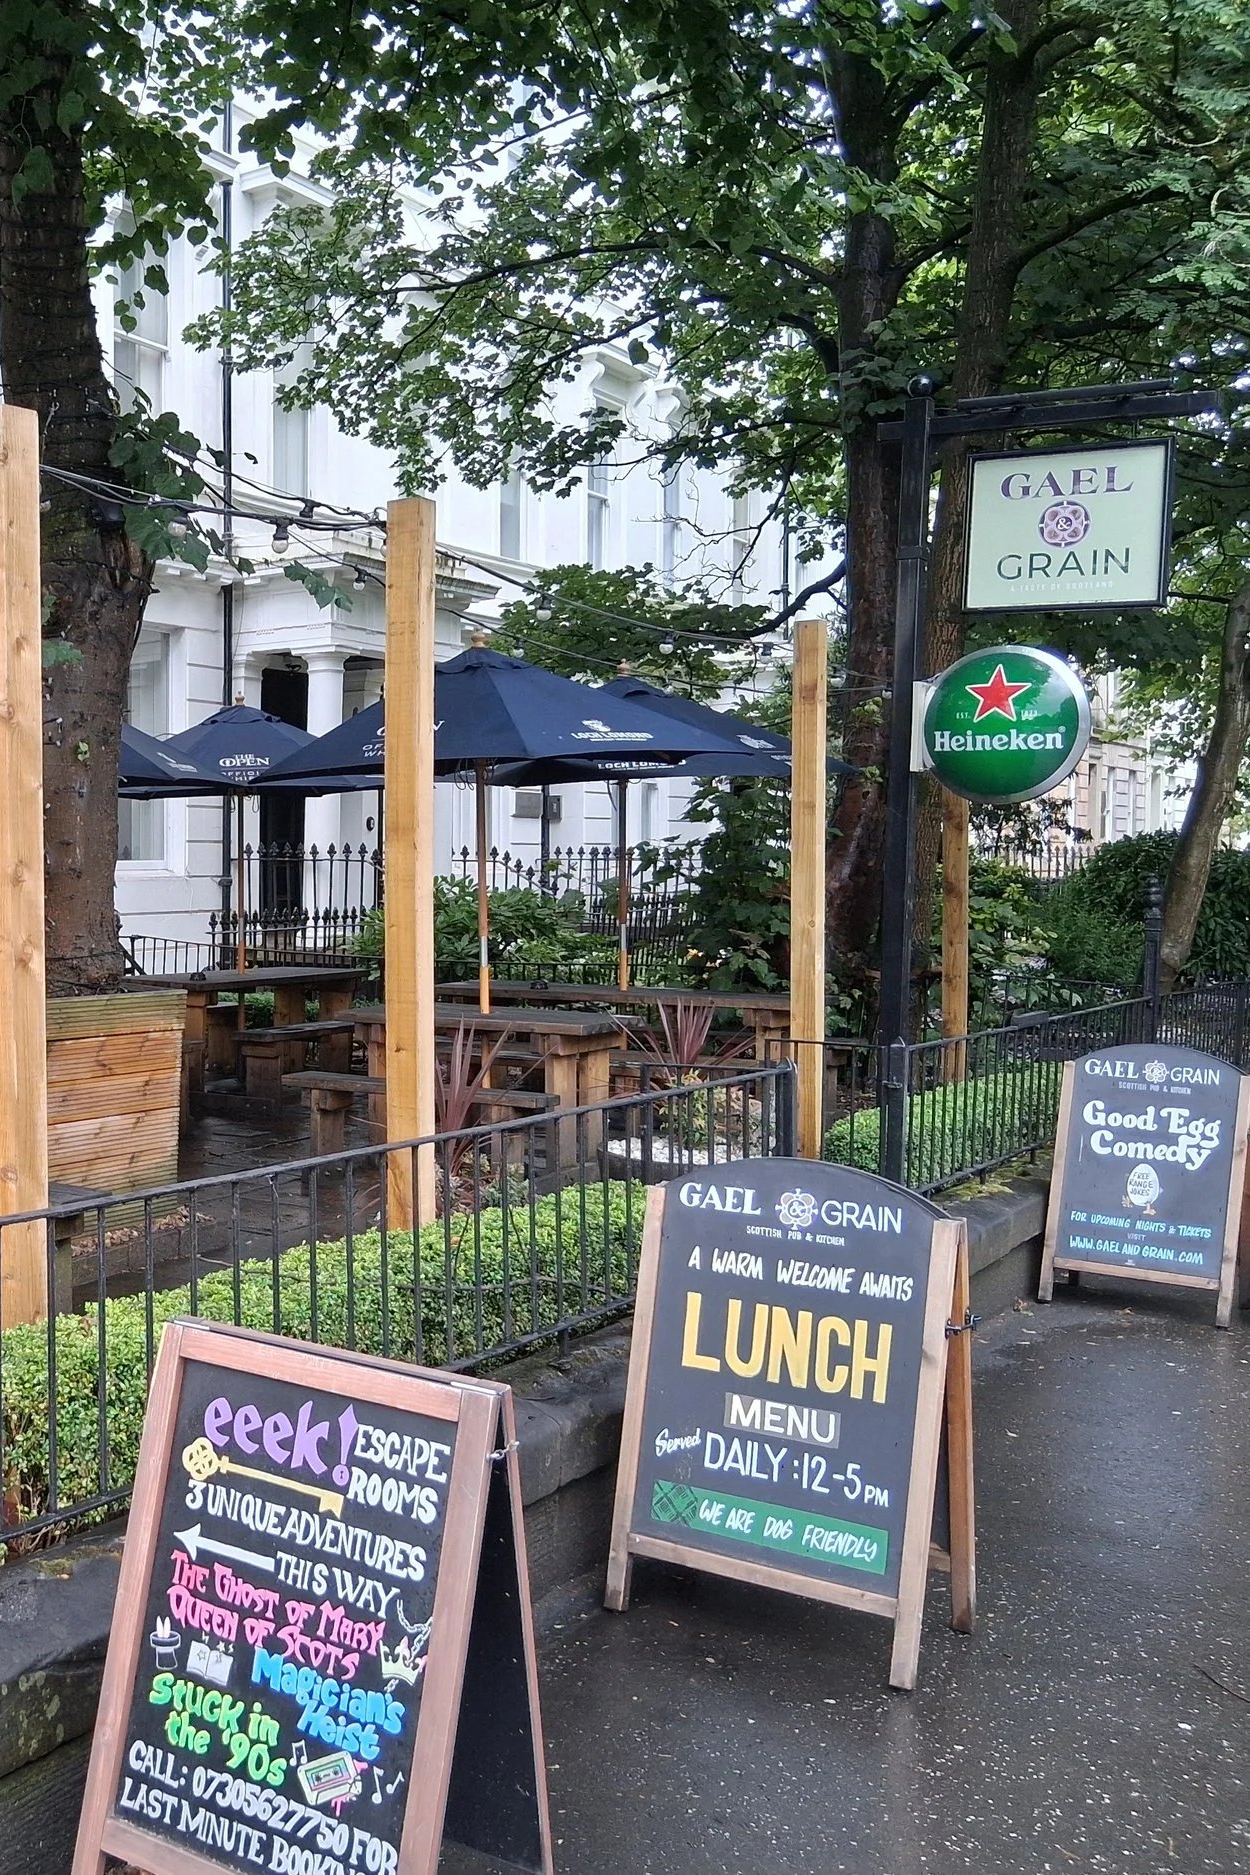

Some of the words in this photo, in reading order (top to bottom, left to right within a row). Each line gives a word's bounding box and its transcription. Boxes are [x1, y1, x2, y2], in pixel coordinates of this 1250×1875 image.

[1000, 465, 1134, 501] GAEL
[996, 547, 1130, 581] GRAIN
[219, 757, 270, 767] OPEN
[934, 728, 1064, 752] Heineken
[1084, 1059, 1139, 1079] GAEL
[1170, 1067, 1220, 1085] GRAIN
[1083, 1100, 1158, 1132] Good
[1159, 1107, 1222, 1149] Egg
[1090, 1129, 1212, 1171] Comedy
[1129, 1178, 1154, 1189] RANGE
[1133, 1172, 1151, 1180] FREE
[679, 1182, 761, 1216] GAEL
[821, 1200, 902, 1234] GRAIN
[1070, 1210, 1087, 1222] FOR
[1091, 1214, 1131, 1228] UPCOMING
[1135, 1220, 1166, 1233] NIGHTS
[1177, 1225, 1212, 1239] TICKETS
[746, 1225, 782, 1239] SCOTTISH
[787, 1230, 802, 1240] PUB
[815, 1233, 845, 1246] KITCHEN
[1127, 1232, 1147, 1241] VISIT
[688, 1246, 701, 1270] A
[712, 1248, 764, 1281] WARM
[777, 1259, 856, 1294] WELCOME
[859, 1271, 914, 1302] AWAITS
[681, 1291, 893, 1404] LUNCH
[204, 1397, 359, 1487] eeek!
[353, 1423, 450, 1484] ESCAPE
[729, 1394, 836, 1443] MENU
[655, 1428, 701, 1457] Served
[703, 1431, 787, 1482] DAILY
[346, 1466, 439, 1525] ROOMS
[185, 1478, 208, 1510] 3
[206, 1484, 287, 1535] UNIQUE
[280, 1510, 427, 1582] ADVENTURES
[699, 1499, 725, 1526] WE
[725, 1507, 756, 1534] ARE
[763, 1516, 793, 1540] DOG
[802, 1524, 878, 1563] FRIENDLY
[276, 1551, 329, 1596] THIS
[332, 1567, 401, 1619] WAY
[165, 1710, 211, 1754] the
[248, 1701, 280, 1748] in
[119, 1776, 178, 1825] LAST
[176, 1801, 267, 1865] MINUTE
[192, 1766, 350, 1857] 07305627750
[349, 1827, 399, 1875] FOR
